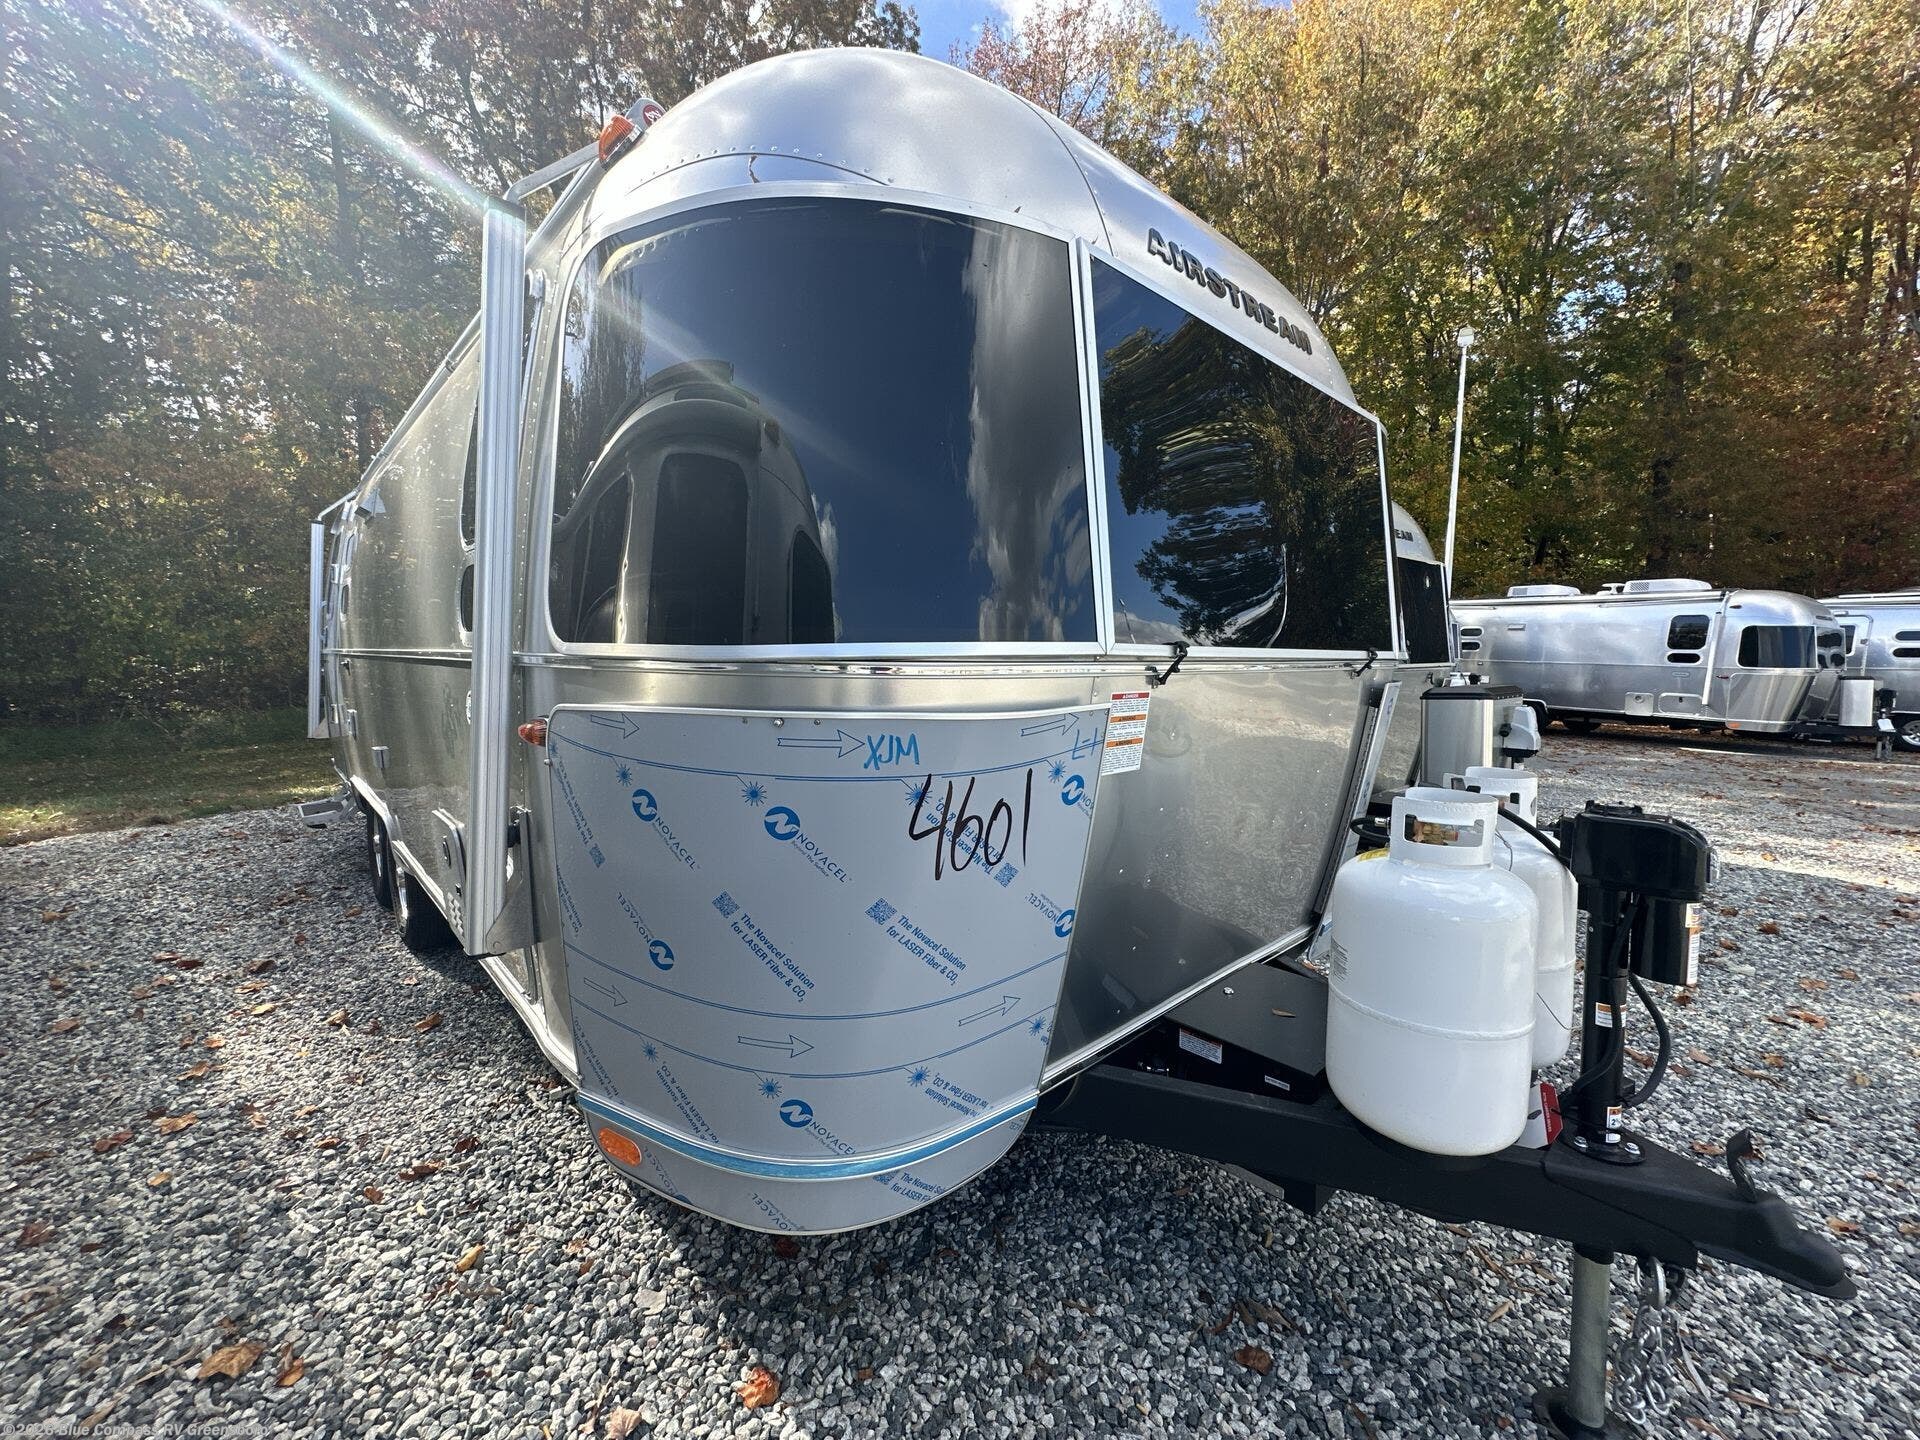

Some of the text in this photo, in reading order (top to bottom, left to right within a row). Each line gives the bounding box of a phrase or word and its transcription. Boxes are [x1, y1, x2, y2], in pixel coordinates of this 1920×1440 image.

[1148, 227, 1312, 355] AIRSTREAM
[863, 733, 920, 770] XJM
[656, 817, 696, 870] NOVACEL
[908, 768, 1033, 881] 4601
[796, 833, 846, 882] NOVACEL
[618, 892, 652, 944] NOVACEL
[1028, 892, 1056, 922] NOVACEL
[731, 922, 743, 934] for
[742, 934, 768, 960] LASER
[766, 959, 786, 980] Fiber
[741, 913, 815, 989] The Novacel Solution
[886, 926, 900, 938] for
[898, 935, 924, 958] LASER
[922, 953, 941, 970] Fiber
[940, 966, 948, 974] &
[898, 915, 966, 970] The Novacel Solution
[656, 1070, 700, 1134] Novacel Solution
[676, 1086, 691, 1106] Fiber
[690, 1106, 710, 1132] LASER
[925, 1088, 950, 1106] Solution
[891, 1183, 902, 1192] for
[900, 1187, 922, 1202] LASER
[901, 1172, 913, 1184] The
[912, 1178, 937, 1194] Novacel
